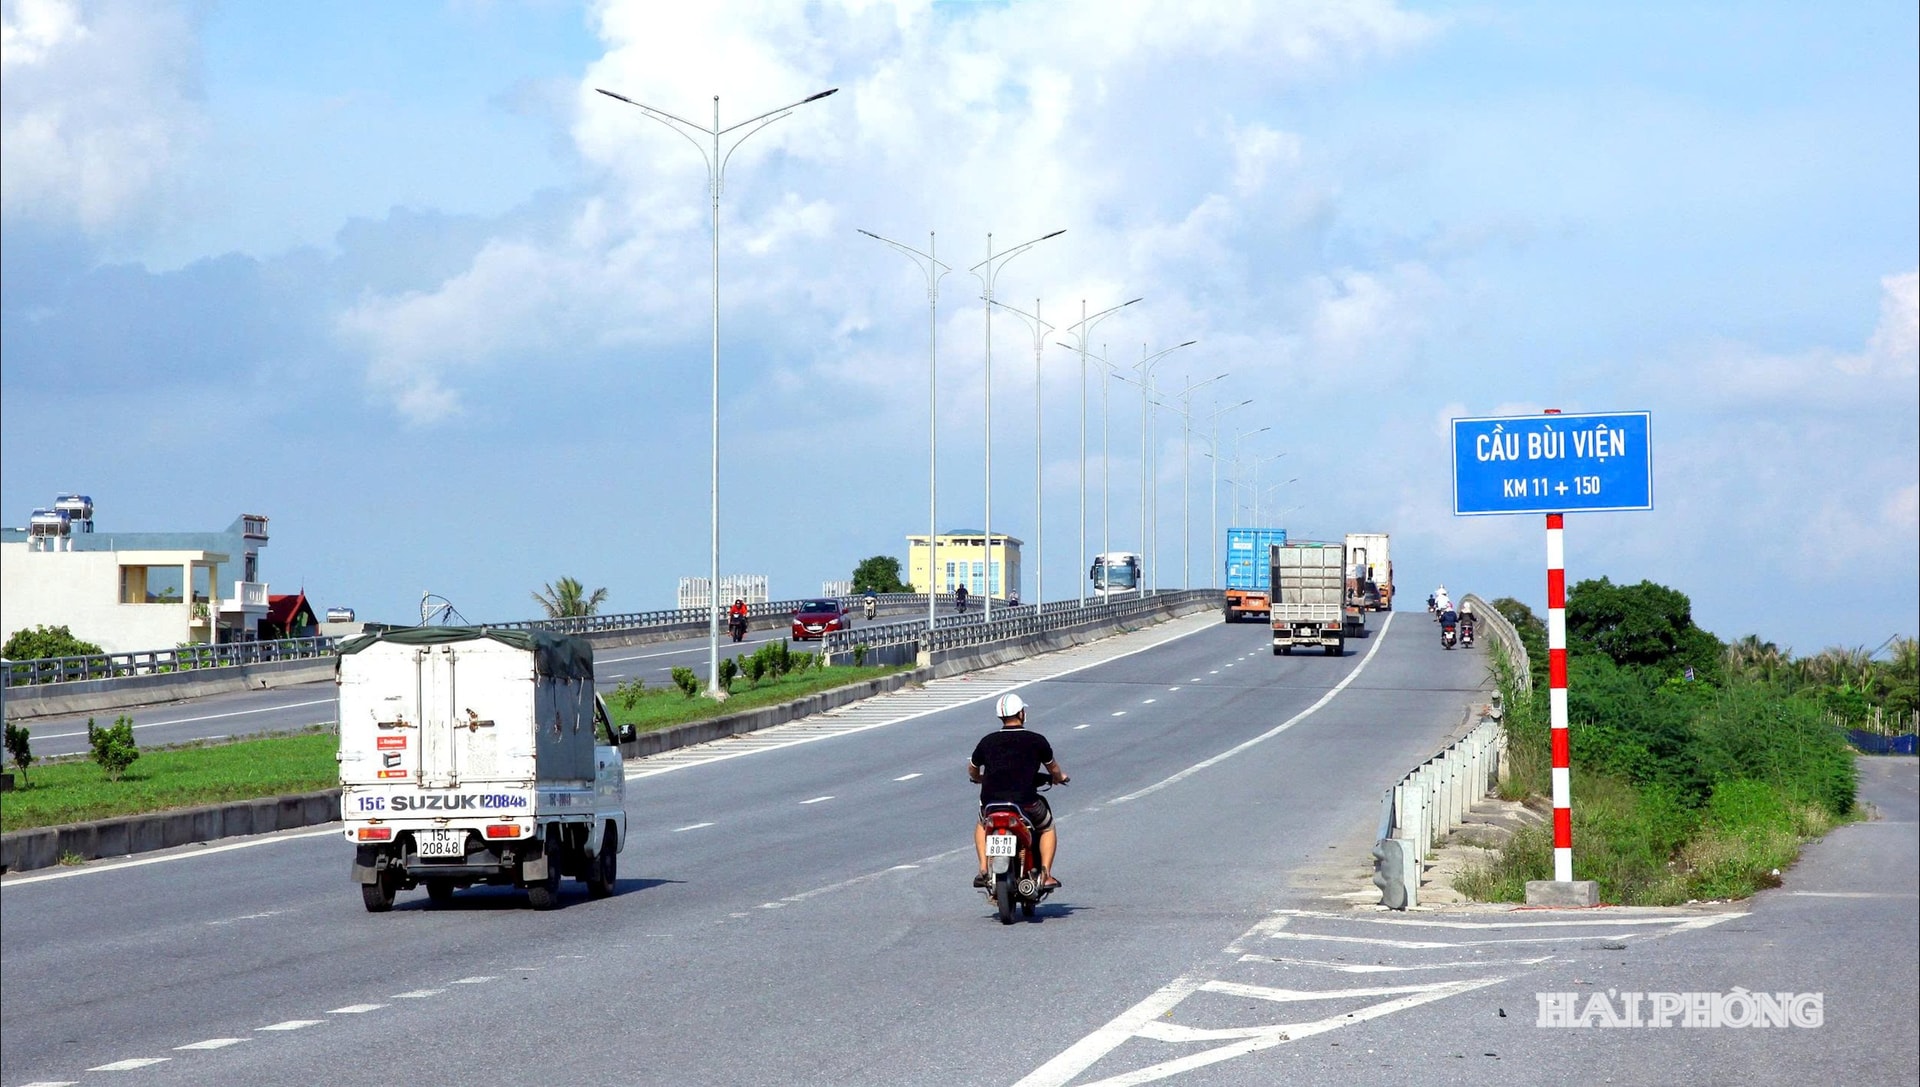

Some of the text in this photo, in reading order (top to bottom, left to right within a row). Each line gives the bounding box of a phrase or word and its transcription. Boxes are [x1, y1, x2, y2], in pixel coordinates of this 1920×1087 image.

[1477, 423, 1625, 463] CẦU BÙI VIỆN
[1504, 476, 1600, 498] KM 11 + 150
[358, 796, 385, 811] 15C
[391, 794, 484, 811] SUZUKI
[431, 829, 450, 842] 15C
[422, 842, 459, 854] 208.48
